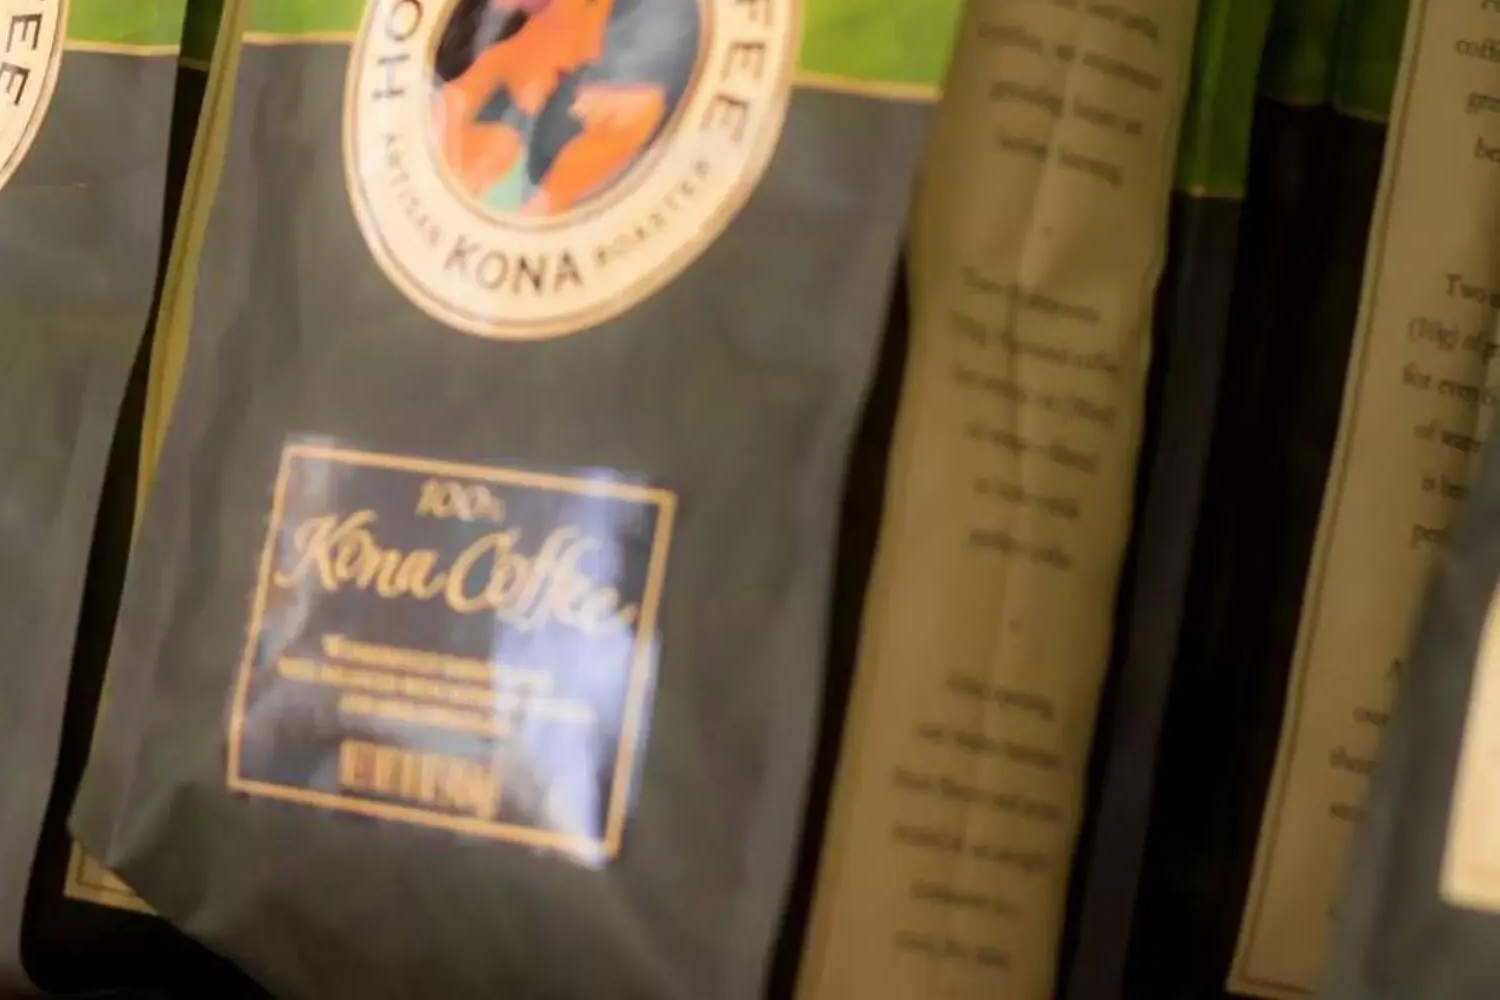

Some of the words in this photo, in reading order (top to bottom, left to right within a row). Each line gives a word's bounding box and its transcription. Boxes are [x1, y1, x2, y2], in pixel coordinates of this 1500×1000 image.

[443, 232, 586, 296] KONA
[274, 508, 447, 601] Kona
[444, 524, 639, 635] Coffee
